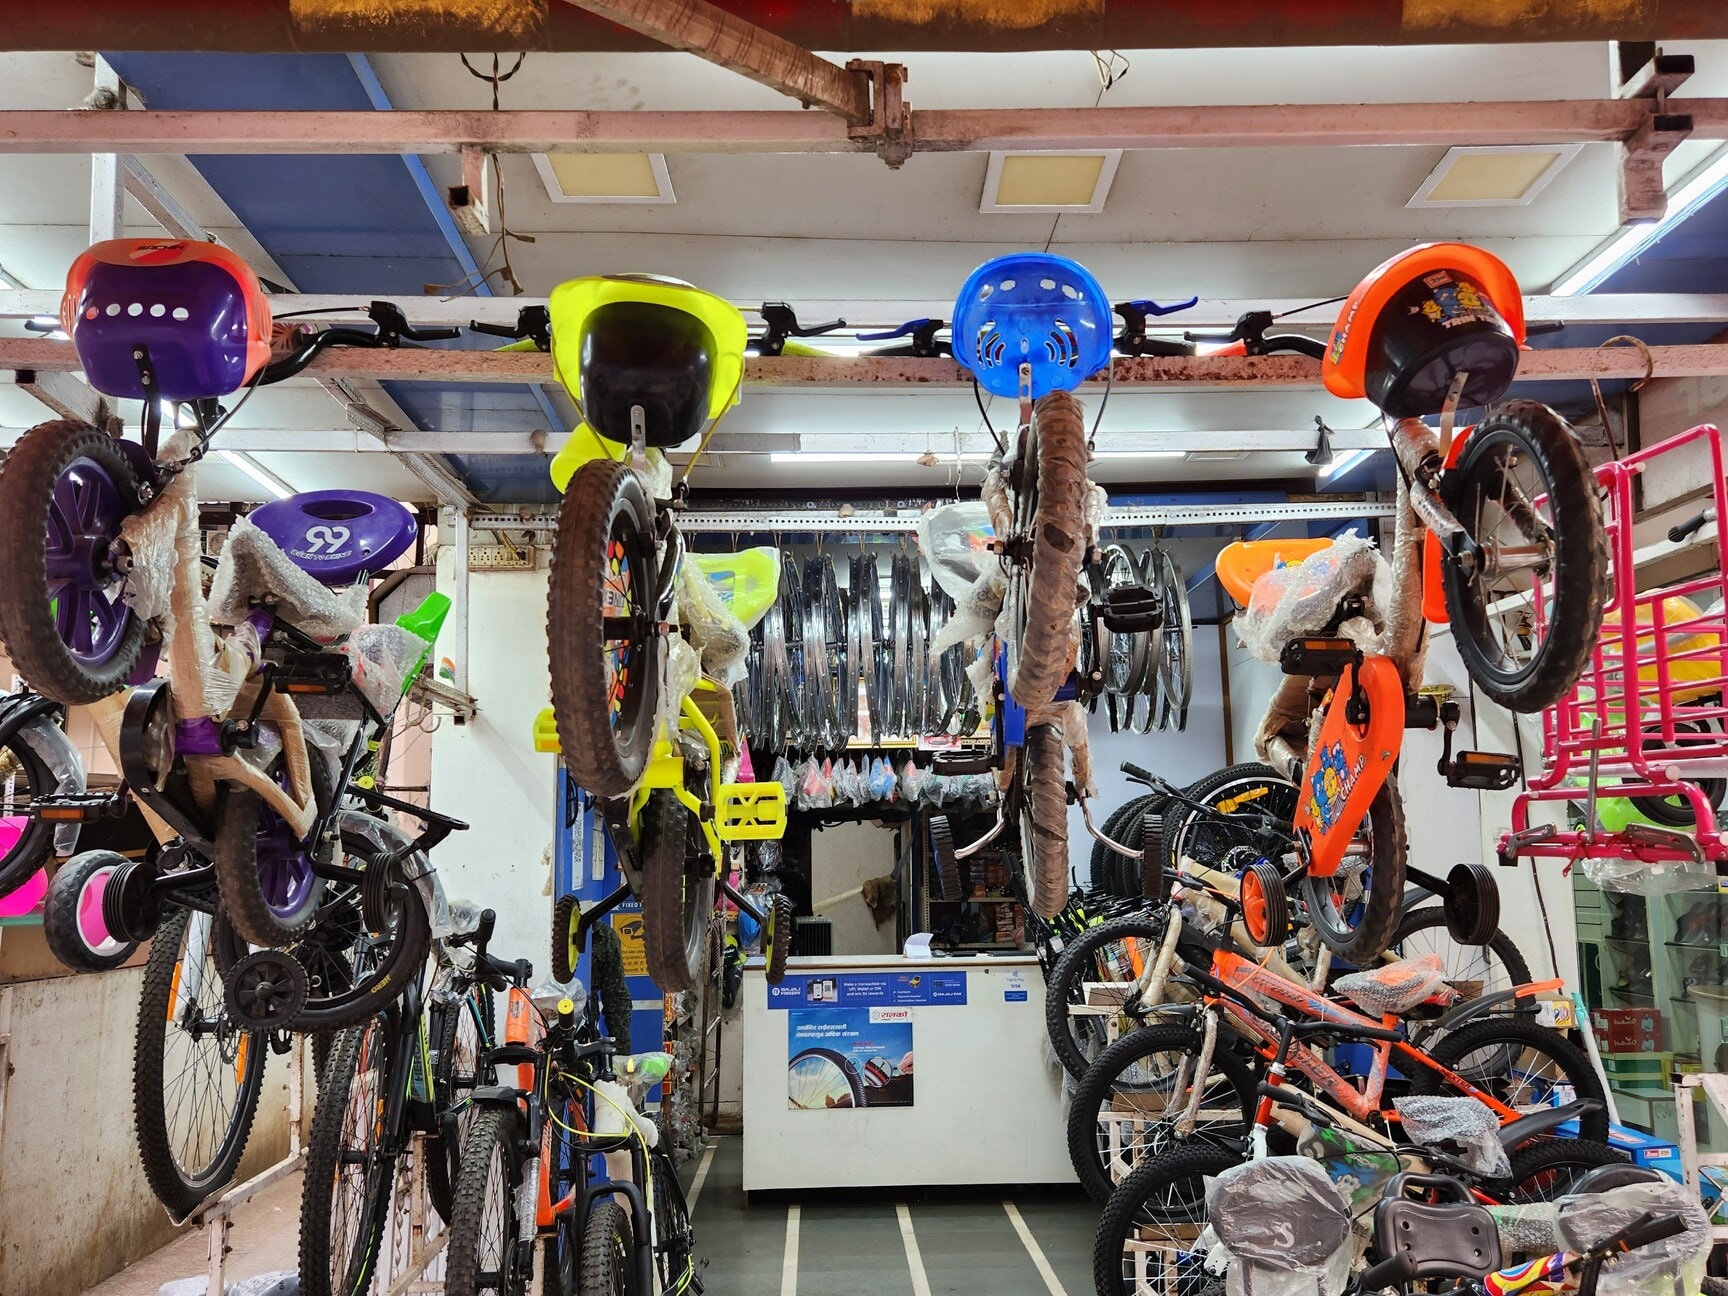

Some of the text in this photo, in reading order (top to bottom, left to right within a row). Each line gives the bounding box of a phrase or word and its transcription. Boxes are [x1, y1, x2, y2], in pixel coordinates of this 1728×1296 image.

[305, 525, 351, 554] 99
[1340, 754, 1366, 802] CHAMP
[371, 974, 391, 994] HERO
